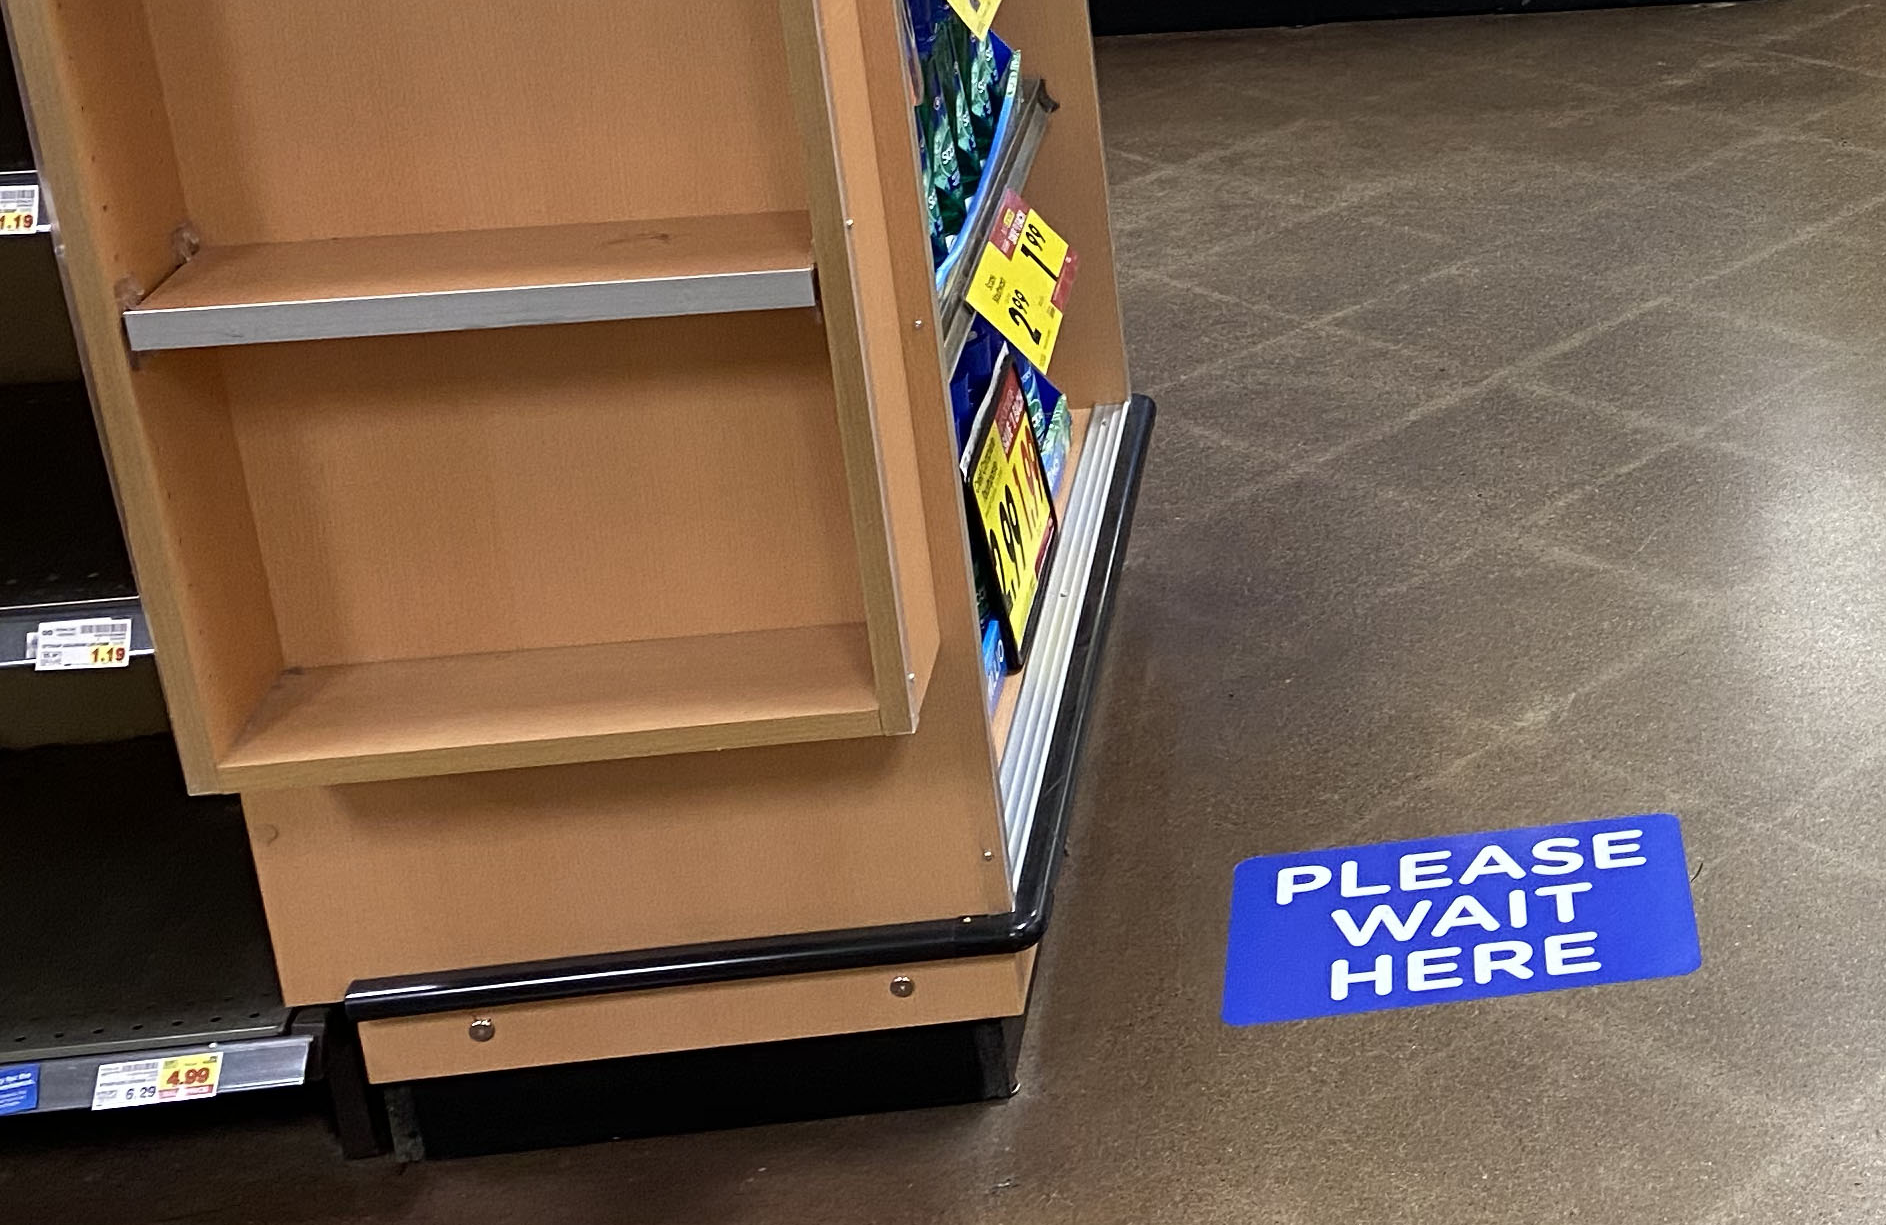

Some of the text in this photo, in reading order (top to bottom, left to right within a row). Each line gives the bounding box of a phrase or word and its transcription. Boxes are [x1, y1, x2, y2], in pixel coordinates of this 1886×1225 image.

[1020, 223, 1059, 282] 1 99
[1008, 288, 1042, 346] 2 99
[91, 647, 126, 663] 1.19
[1276, 828, 1647, 906] PLEASE
[1331, 881, 1593, 948] WAIT
[1330, 931, 1602, 1001] HERE
[125, 1085, 157, 1101] 6.29
[166, 1067, 210, 1087] 4.99
